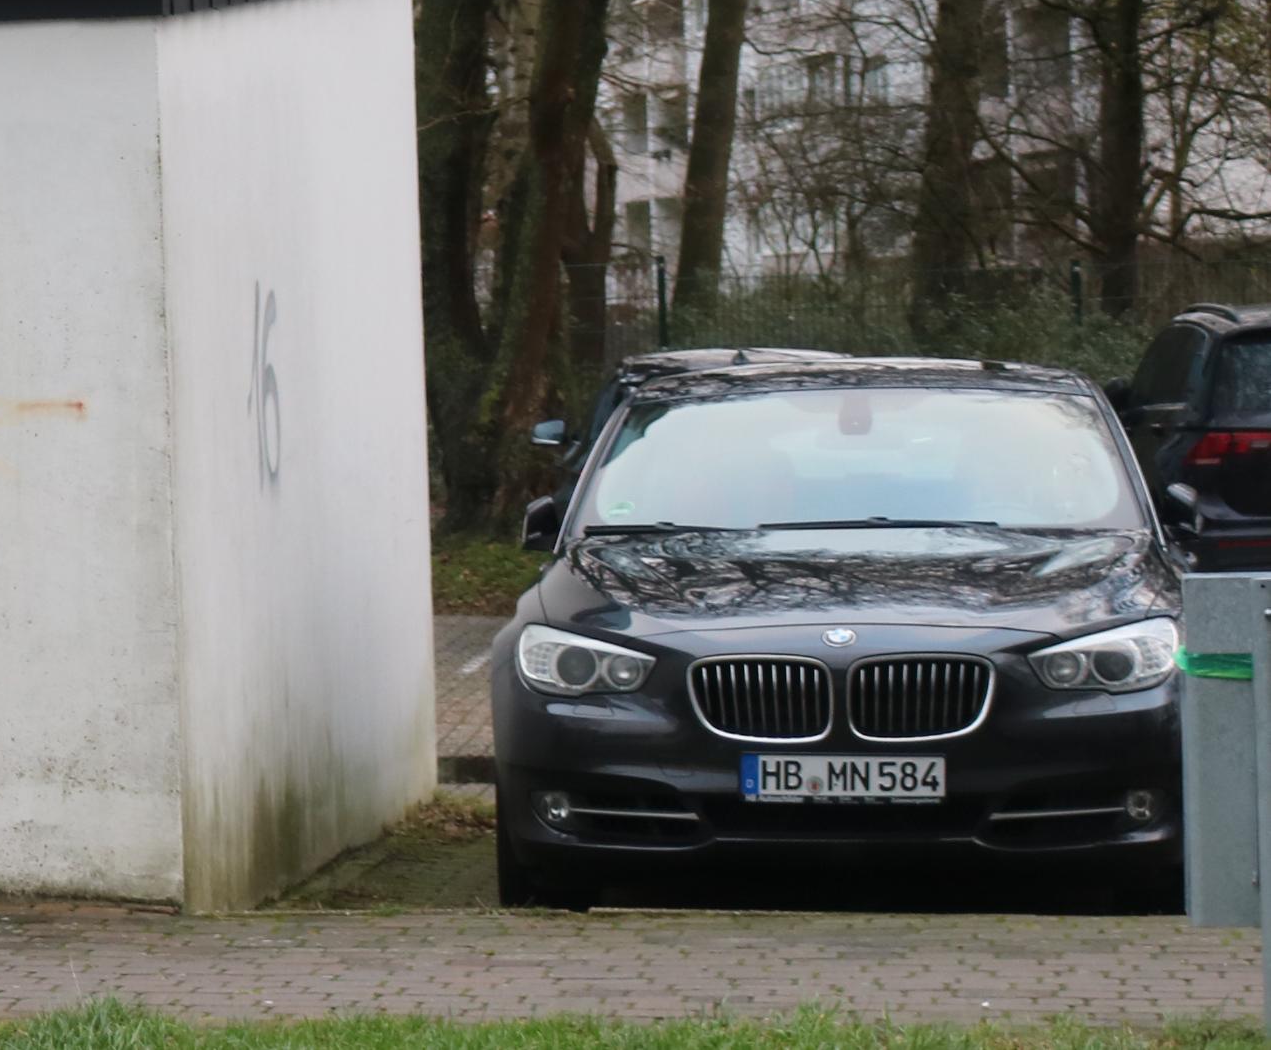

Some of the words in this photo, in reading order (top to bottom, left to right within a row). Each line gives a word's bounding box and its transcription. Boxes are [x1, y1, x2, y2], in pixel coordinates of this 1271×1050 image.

[761, 760, 803, 791] HB
[827, 761, 870, 792] MN
[877, 760, 940, 792] 584
